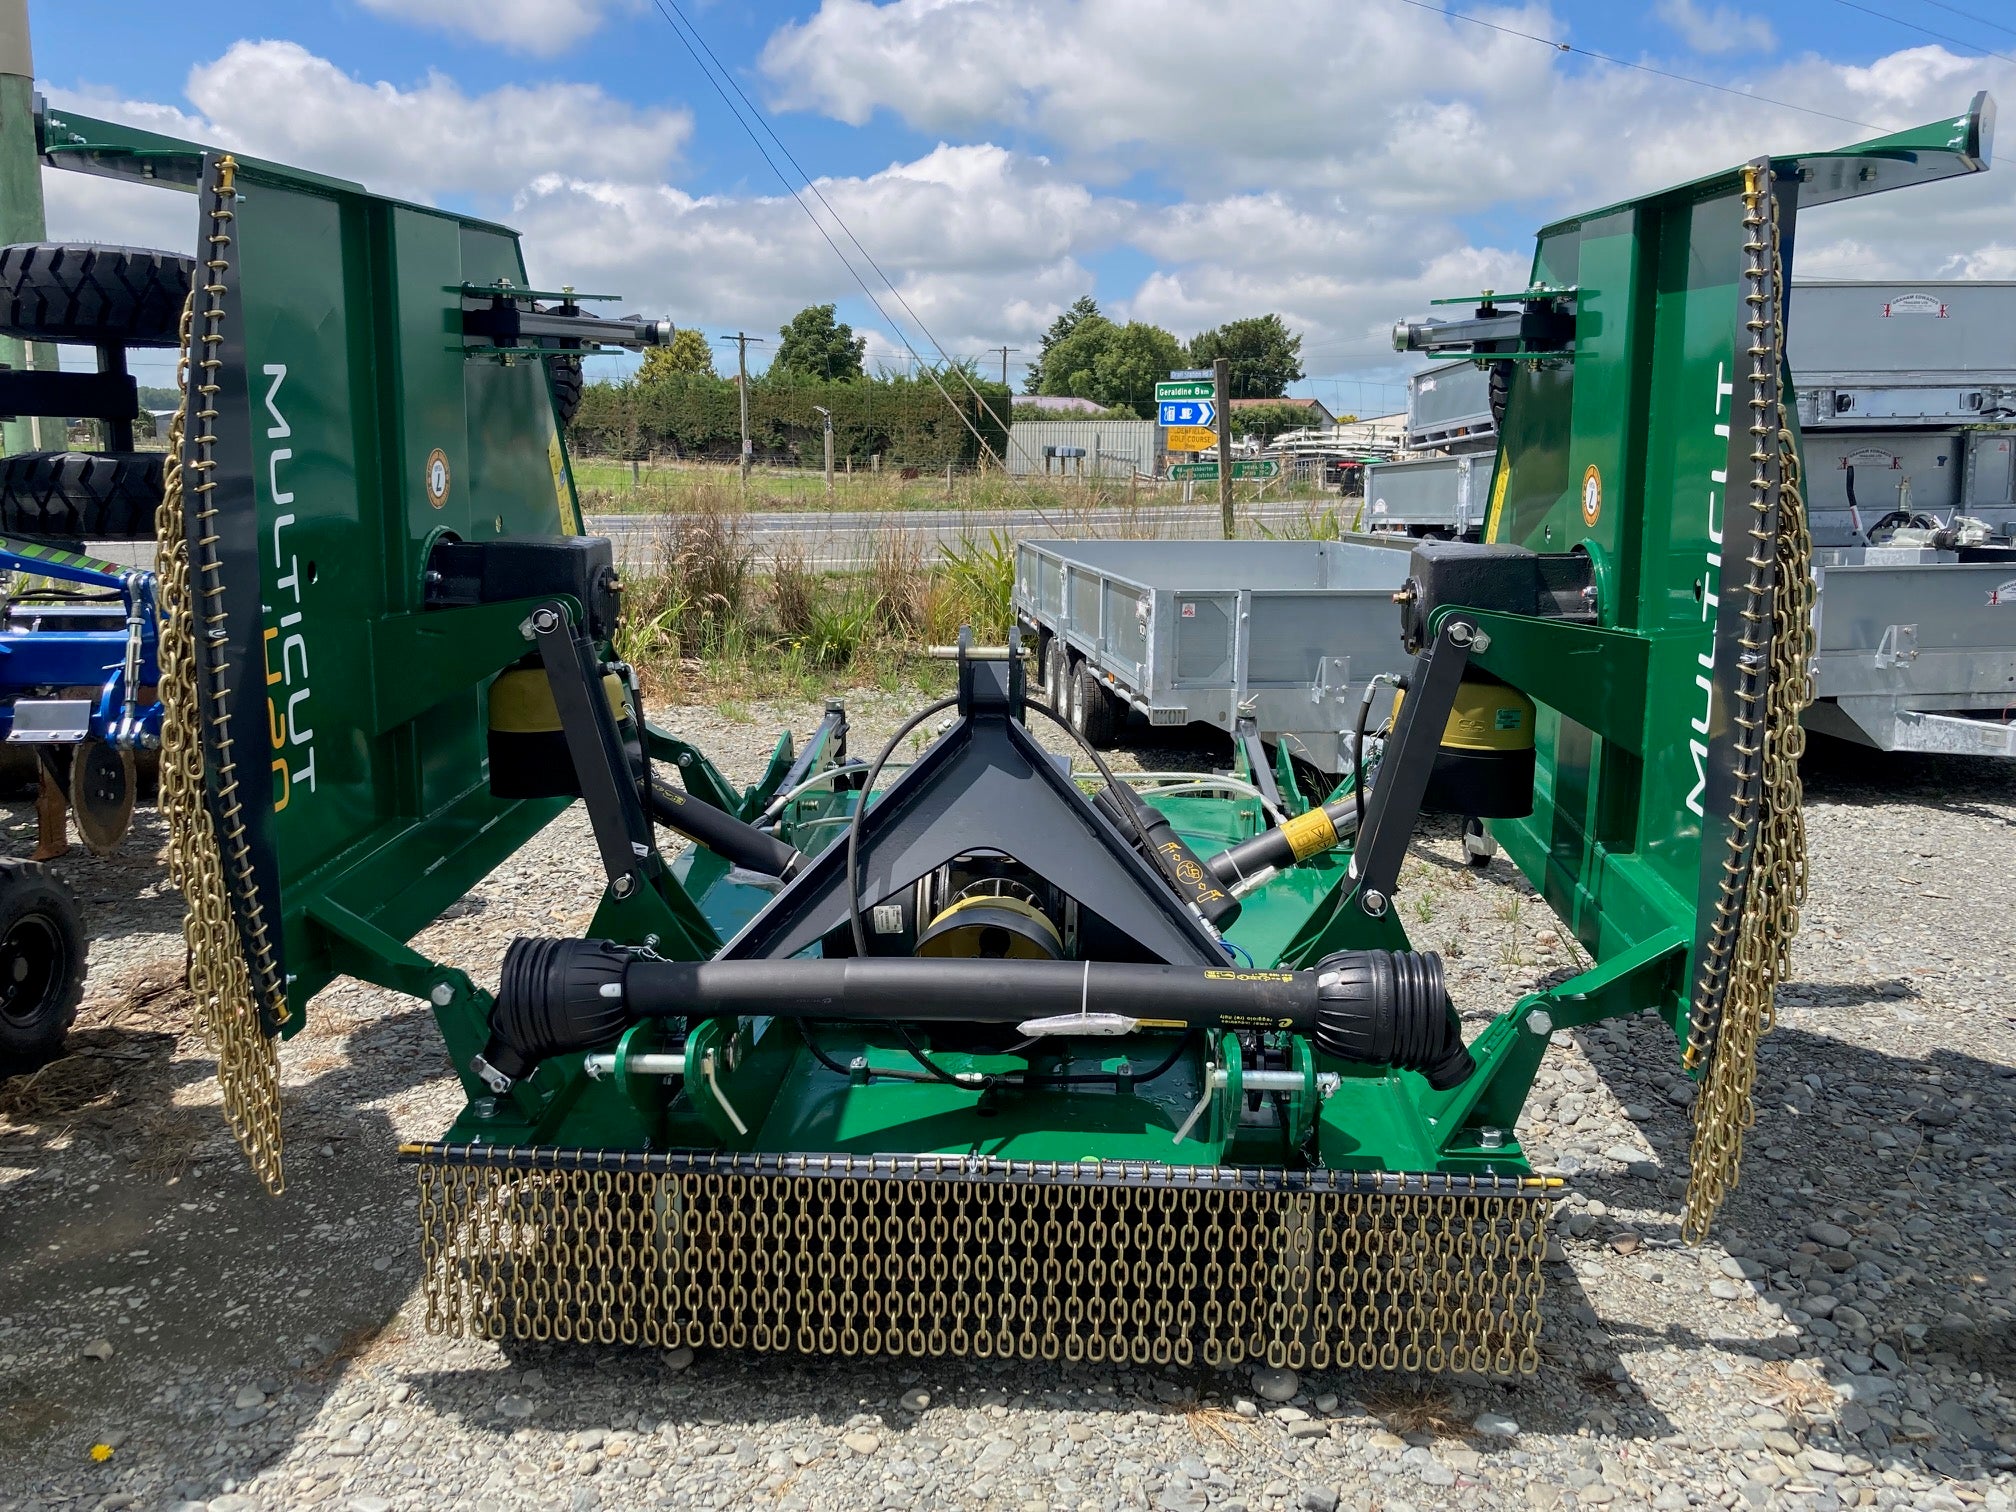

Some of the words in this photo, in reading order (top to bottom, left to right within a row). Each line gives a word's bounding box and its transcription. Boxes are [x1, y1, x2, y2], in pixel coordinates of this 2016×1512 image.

[1892, 295, 1914, 305] GRAHAM
[1915, 294, 1939, 305] EDWARDS
[1159, 387, 1192, 397] Geraldine
[1170, 434, 1185, 443] GOLF
[1187, 435, 1211, 443] COURSE
[263, 364, 316, 793] MULTICUT
